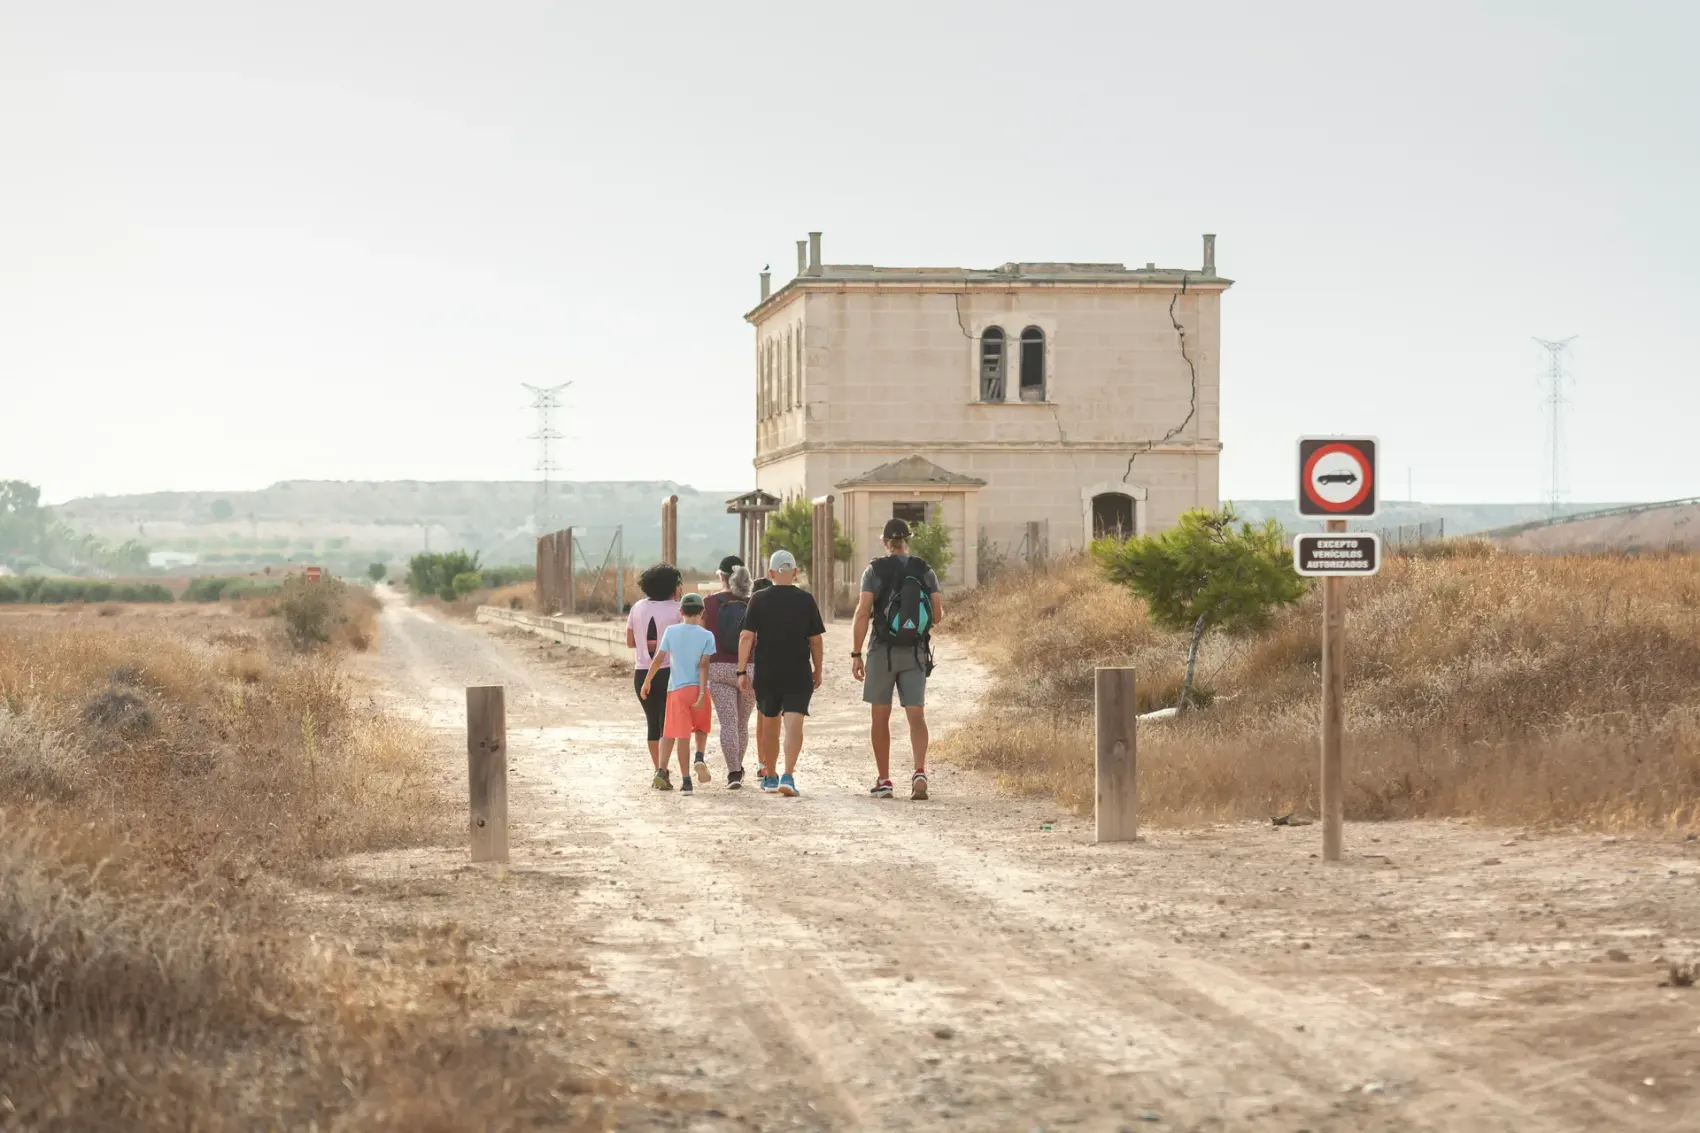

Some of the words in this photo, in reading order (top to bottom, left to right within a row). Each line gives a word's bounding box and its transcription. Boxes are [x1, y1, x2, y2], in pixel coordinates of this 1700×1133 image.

[1317, 540, 1358, 548] EXCEPTO
[1312, 550, 1363, 558] VEHÍCULOS
[1306, 560, 1369, 568] AUTORIZADOS
